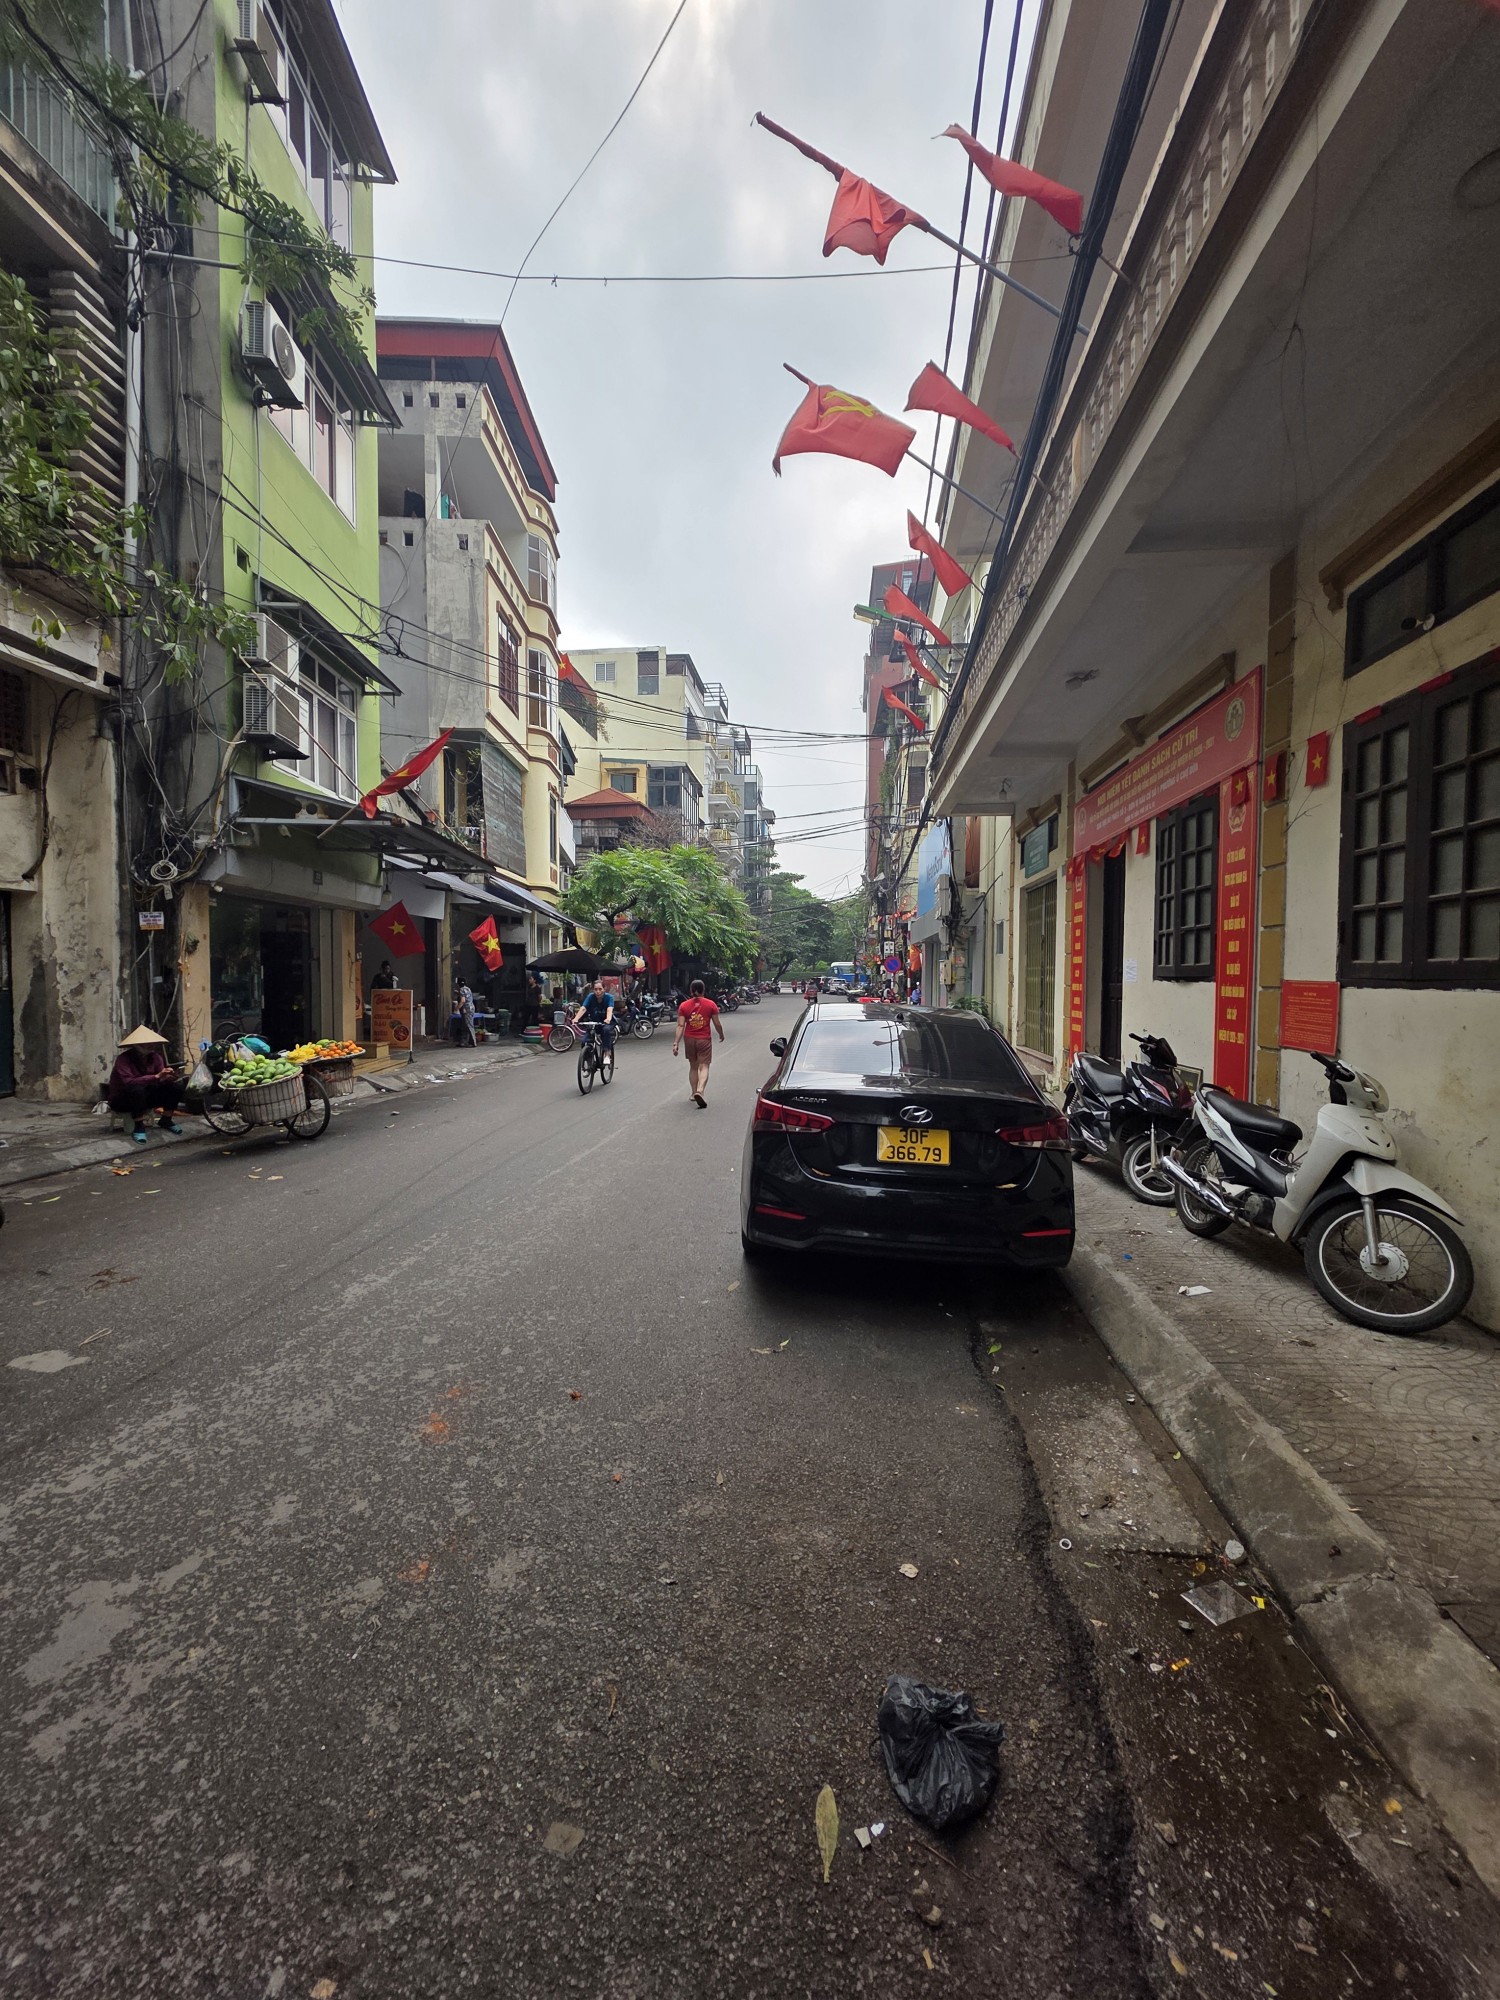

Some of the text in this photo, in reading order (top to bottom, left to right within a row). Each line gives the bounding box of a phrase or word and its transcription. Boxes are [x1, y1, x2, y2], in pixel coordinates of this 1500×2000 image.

[791, 1096, 828, 1104] ACCENT
[899, 1128, 930, 1145] 30F
[886, 1145, 942, 1162] 366.79
